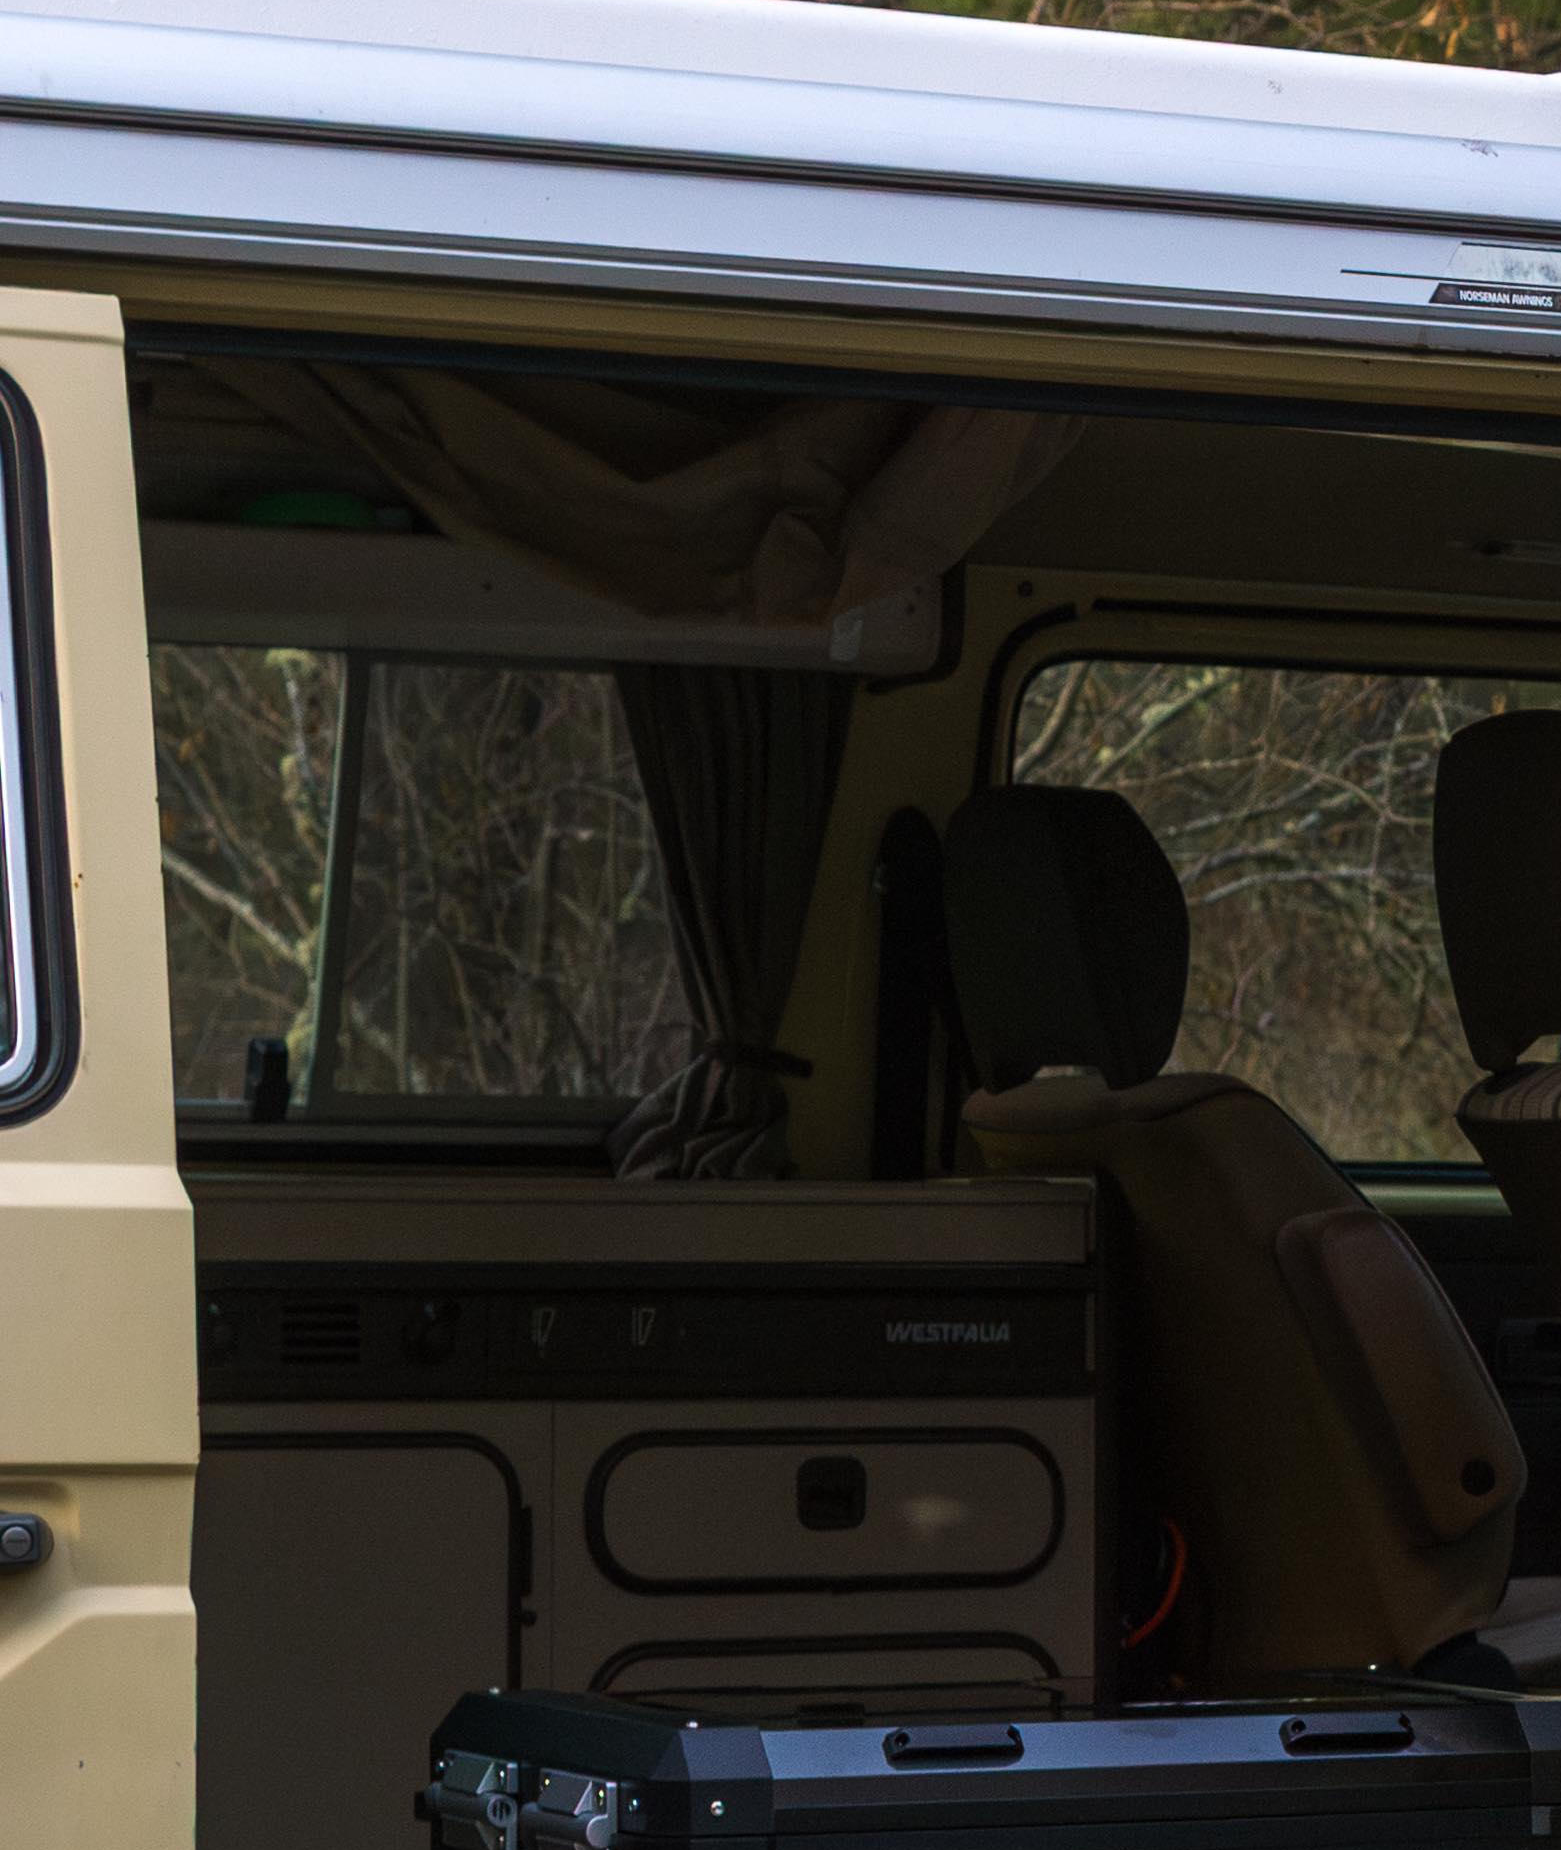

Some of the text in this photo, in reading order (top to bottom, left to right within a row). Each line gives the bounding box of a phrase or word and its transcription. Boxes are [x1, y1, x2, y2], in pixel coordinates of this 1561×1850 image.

[1459, 289, 1554, 308] NORSEMAN AWNINGS
[885, 1321, 1011, 1343] WESTFALIA
